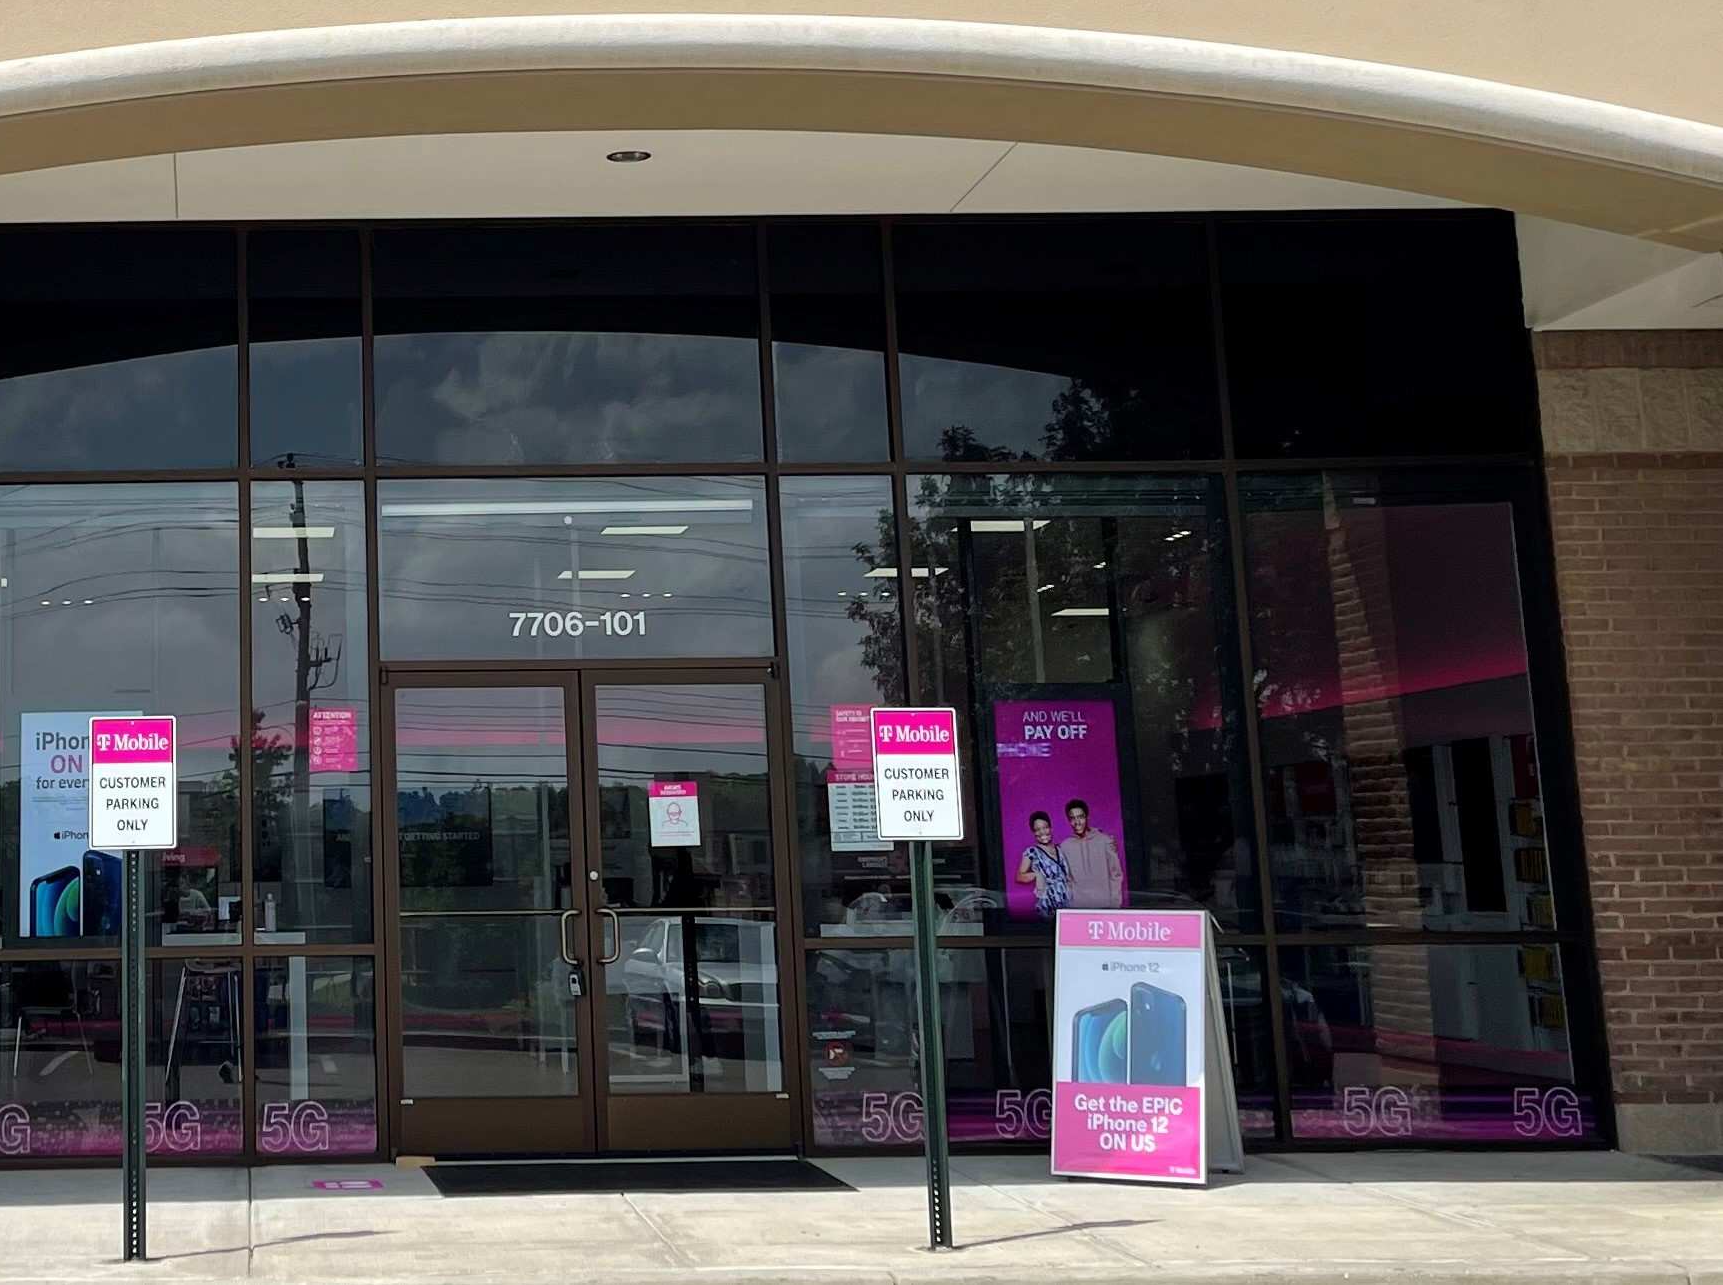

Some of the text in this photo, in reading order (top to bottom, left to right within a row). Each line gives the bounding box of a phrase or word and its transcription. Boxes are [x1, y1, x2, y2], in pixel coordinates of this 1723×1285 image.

[509, 611, 646, 637] 7706-101
[1022, 711, 1085, 723] AND WE'LL
[896, 725, 950, 743] Mobile
[1024, 725, 1088, 740] PAY OFF
[113, 733, 169, 751] Mobile
[50, 754, 83, 774] ON
[36, 776, 55, 789] for
[99, 776, 166, 789] CUSTOMER
[884, 768, 949, 780] CUSTOMER
[106, 797, 159, 810] PARKING
[892, 789, 944, 801] PARKING
[117, 819, 148, 831] ONLY
[904, 810, 934, 822] ONLY
[1107, 921, 1172, 941] Mobile
[1110, 962, 1160, 973] iPhone 12
[1074, 1094, 1183, 1115] Get the EPIC
[1343, 1086, 1412, 1136] 5G
[1513, 1086, 1582, 1136] 5G
[862, 1092, 924, 1142] 5G
[1087, 1113, 1169, 1134] iPhone 12
[261, 1101, 329, 1152] 5G
[1099, 1133, 1156, 1153] ON US
